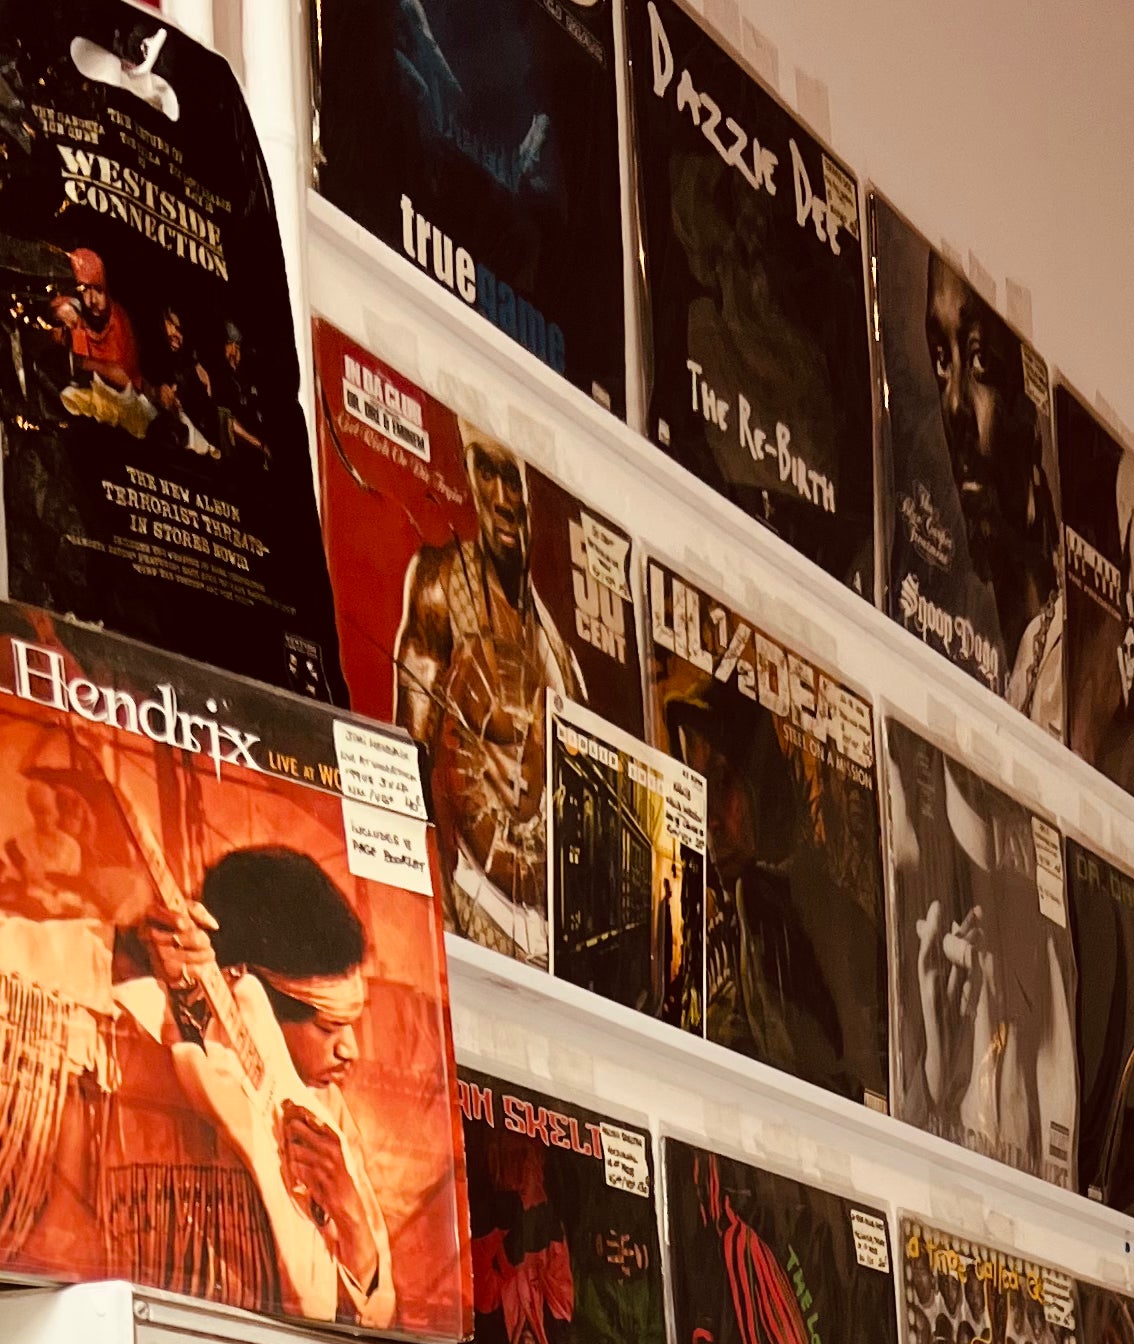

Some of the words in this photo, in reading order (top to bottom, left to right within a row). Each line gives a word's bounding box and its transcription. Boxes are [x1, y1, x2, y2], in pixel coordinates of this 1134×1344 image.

[57, 144, 223, 250] WESTSIDE
[65, 180, 229, 282] CONNECTION
[687, 359, 729, 431] THE
[102, 480, 200, 529] TERRORIST
[125, 465, 155, 491] THE
[159, 478, 190, 502] NEW
[196, 494, 241, 522] ALBUM
[130, 514, 147, 535] IN
[153, 521, 210, 555] STORES
[575, 608, 626, 665] CENT
[650, 563, 713, 676] LIL
[11, 637, 261, 784] Hendrix
[268, 751, 300, 777] LIVE
[304, 766, 314, 781] AT
[502, 1094, 603, 1160] SKELT
